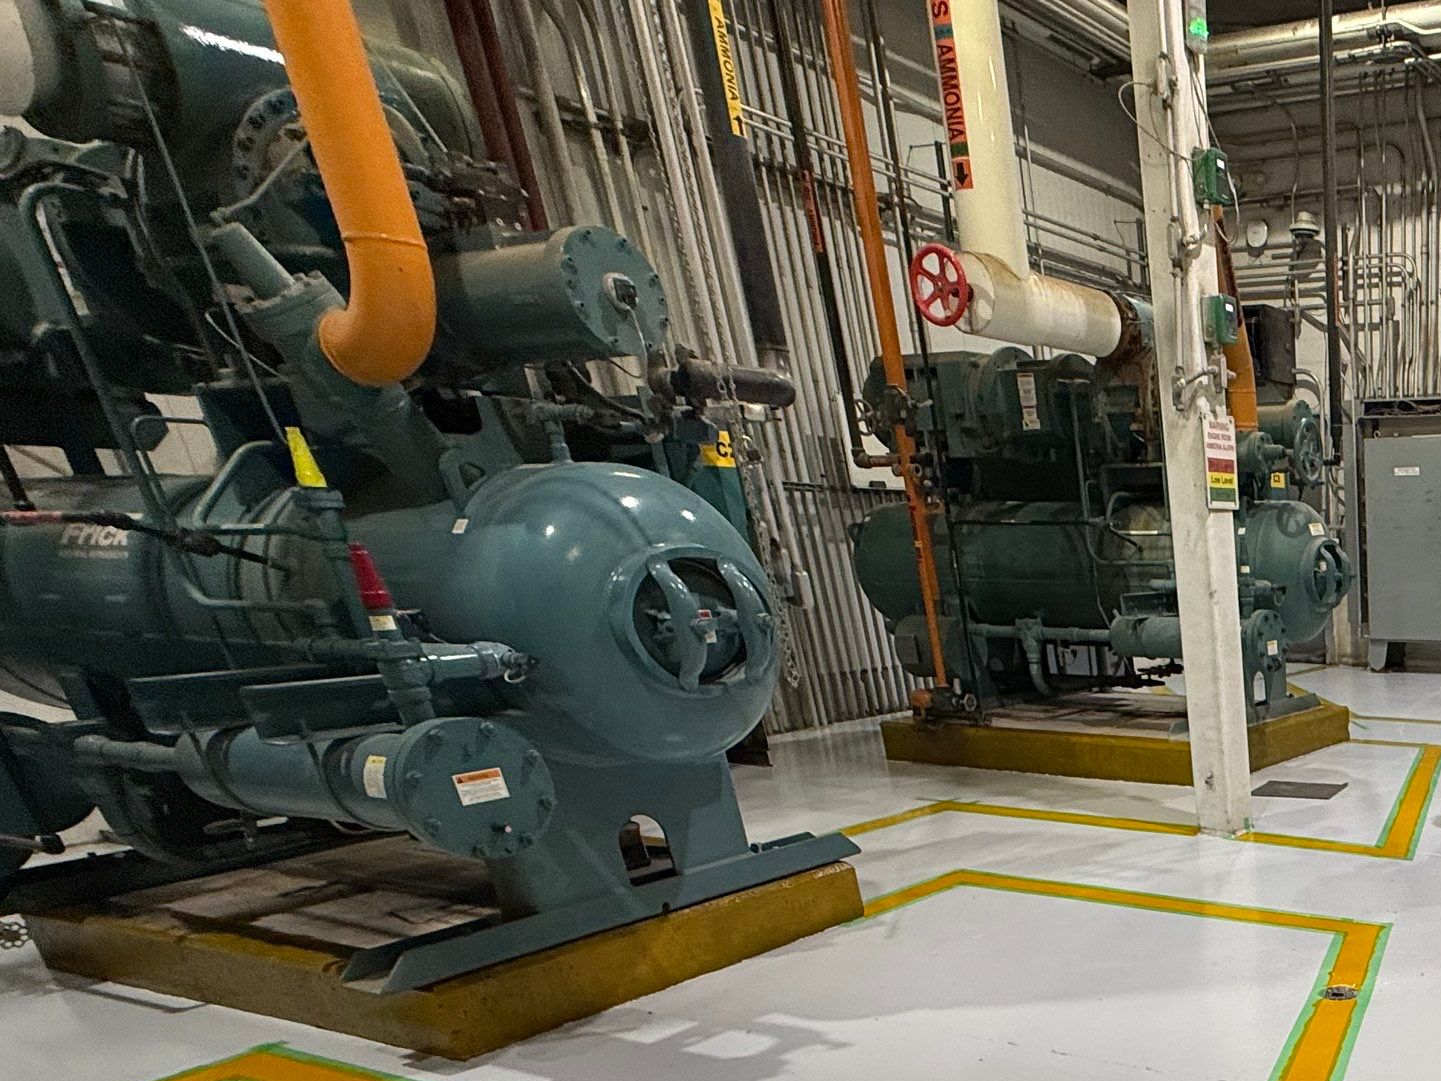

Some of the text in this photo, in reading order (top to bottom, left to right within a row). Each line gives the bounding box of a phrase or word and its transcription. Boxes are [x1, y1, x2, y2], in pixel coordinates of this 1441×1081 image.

[714, 16, 739, 101] AMMONIA
[936, 43, 966, 141] AMMONIA
[715, 441, 734, 458] C
[1222, 476, 1233, 484] Level
